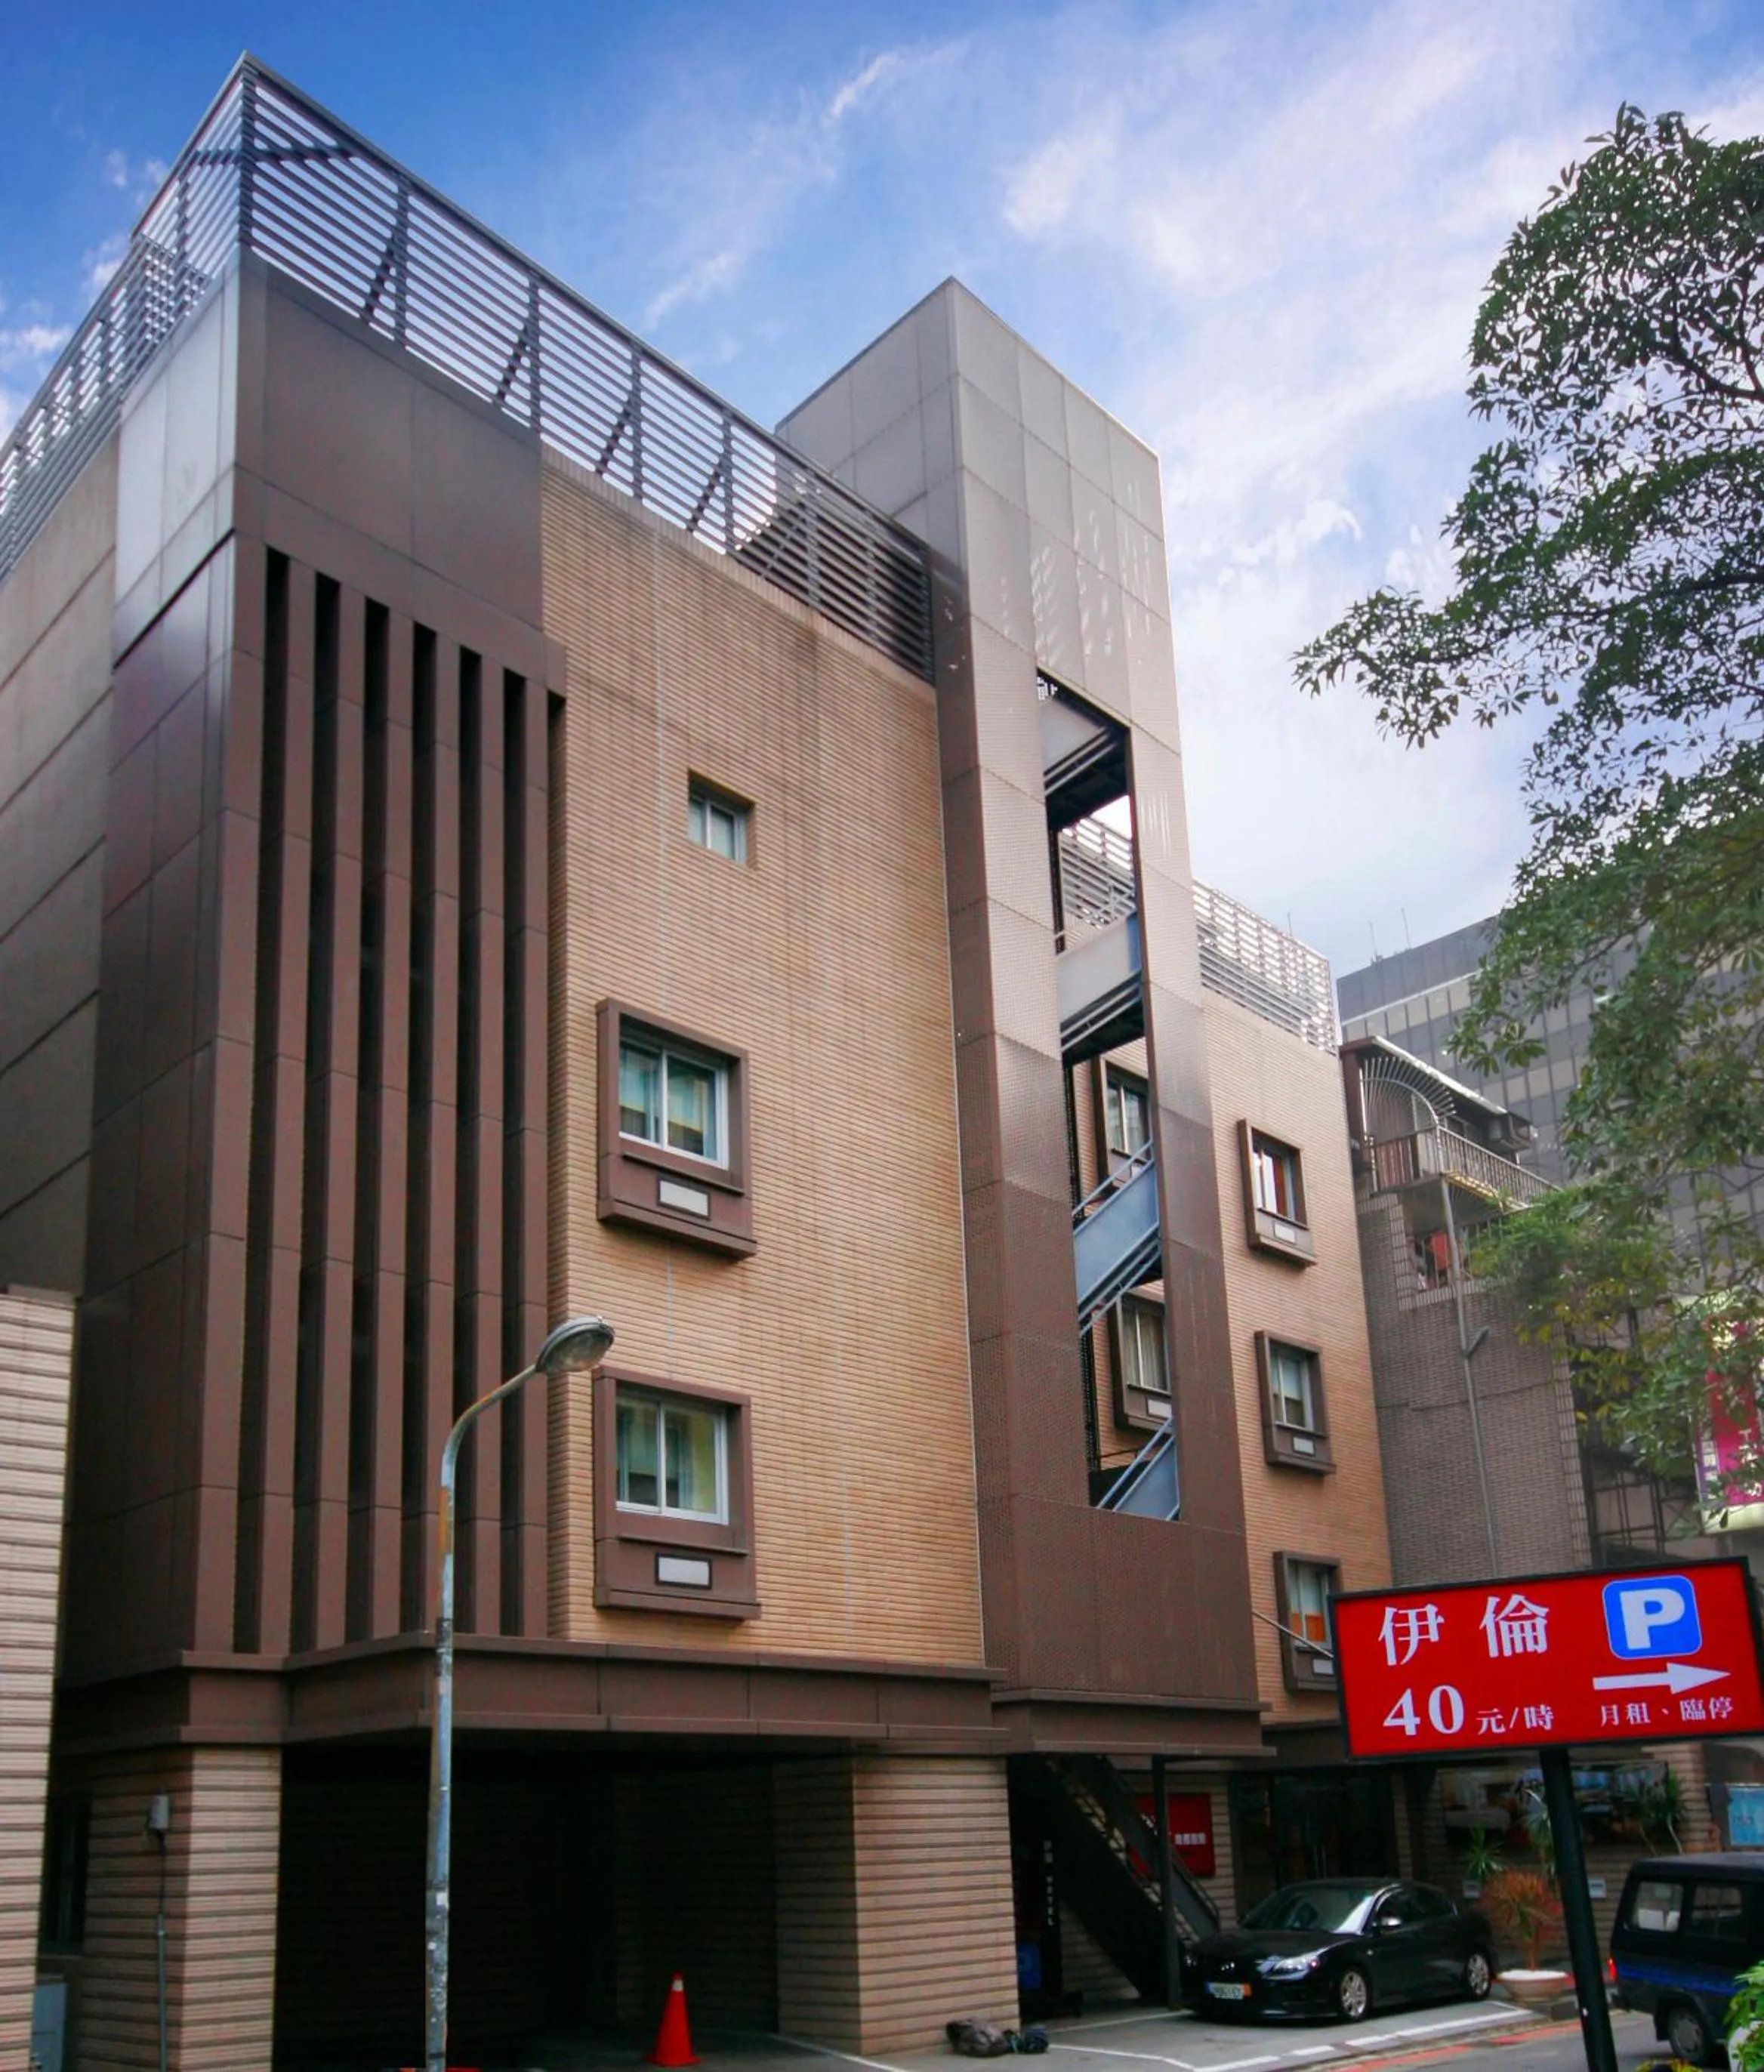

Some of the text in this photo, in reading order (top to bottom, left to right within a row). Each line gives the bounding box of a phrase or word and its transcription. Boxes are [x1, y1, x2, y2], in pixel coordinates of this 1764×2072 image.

[1377, 1593, 1550, 1666] 伊倫
[1618, 1588, 1685, 1650] P
[1383, 1685, 1555, 1735] 40 元/時
[1599, 1696, 1734, 1727] 月租、臨停
